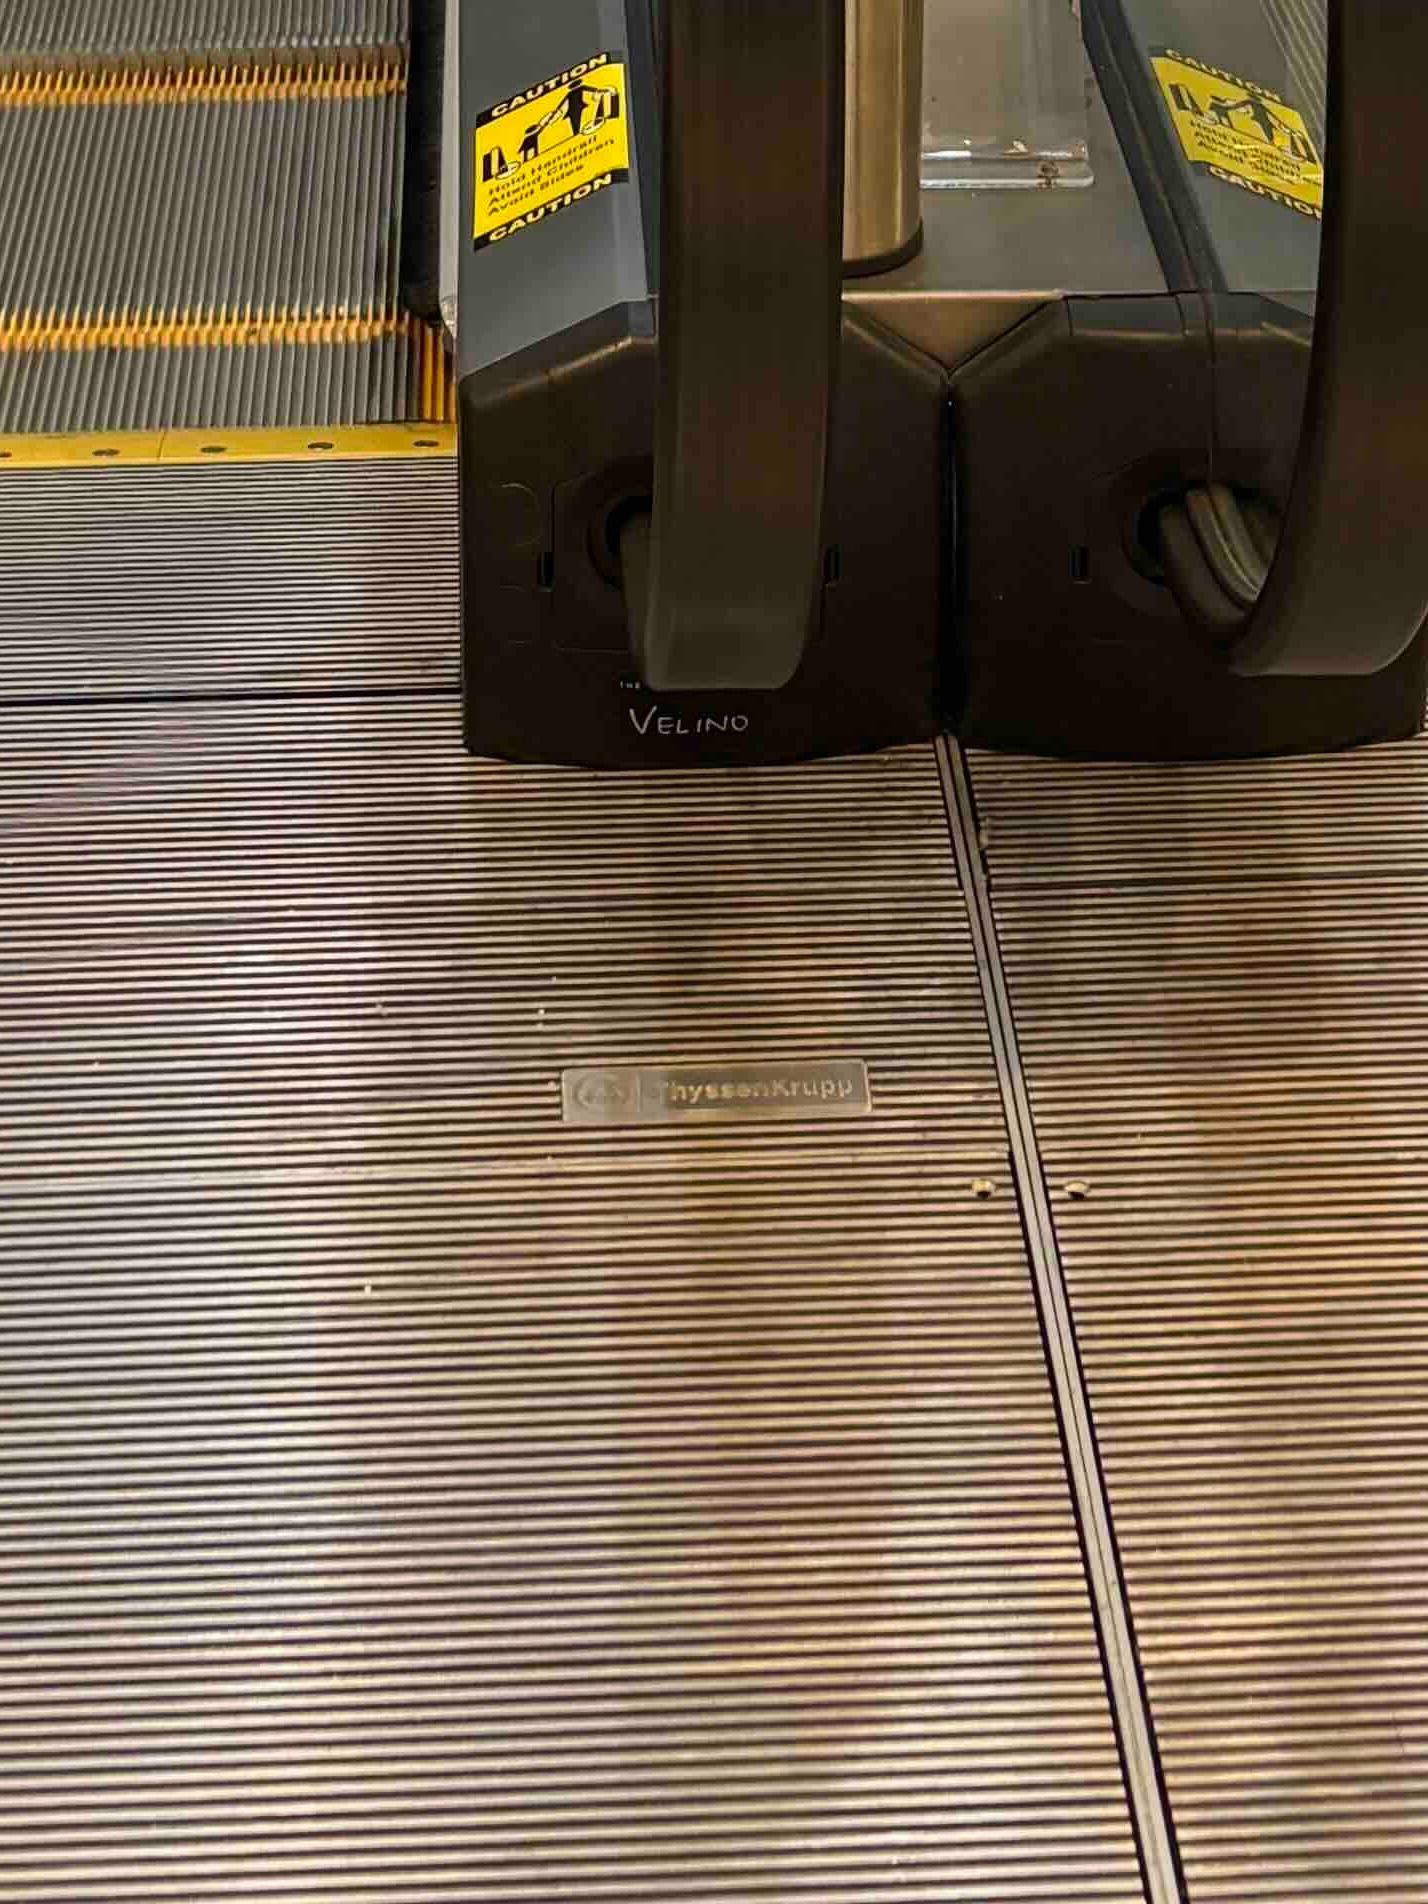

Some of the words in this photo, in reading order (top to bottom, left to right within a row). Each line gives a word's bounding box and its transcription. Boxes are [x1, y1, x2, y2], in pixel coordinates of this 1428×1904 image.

[490, 52, 608, 118] CAUTION
[487, 170, 542, 207] Attend
[488, 171, 527, 196] Hold
[531, 134, 599, 174] Handrail
[488, 187, 536, 217] Avoid
[488, 173, 613, 242] CAUTION
[628, 704, 749, 736] VELINO
